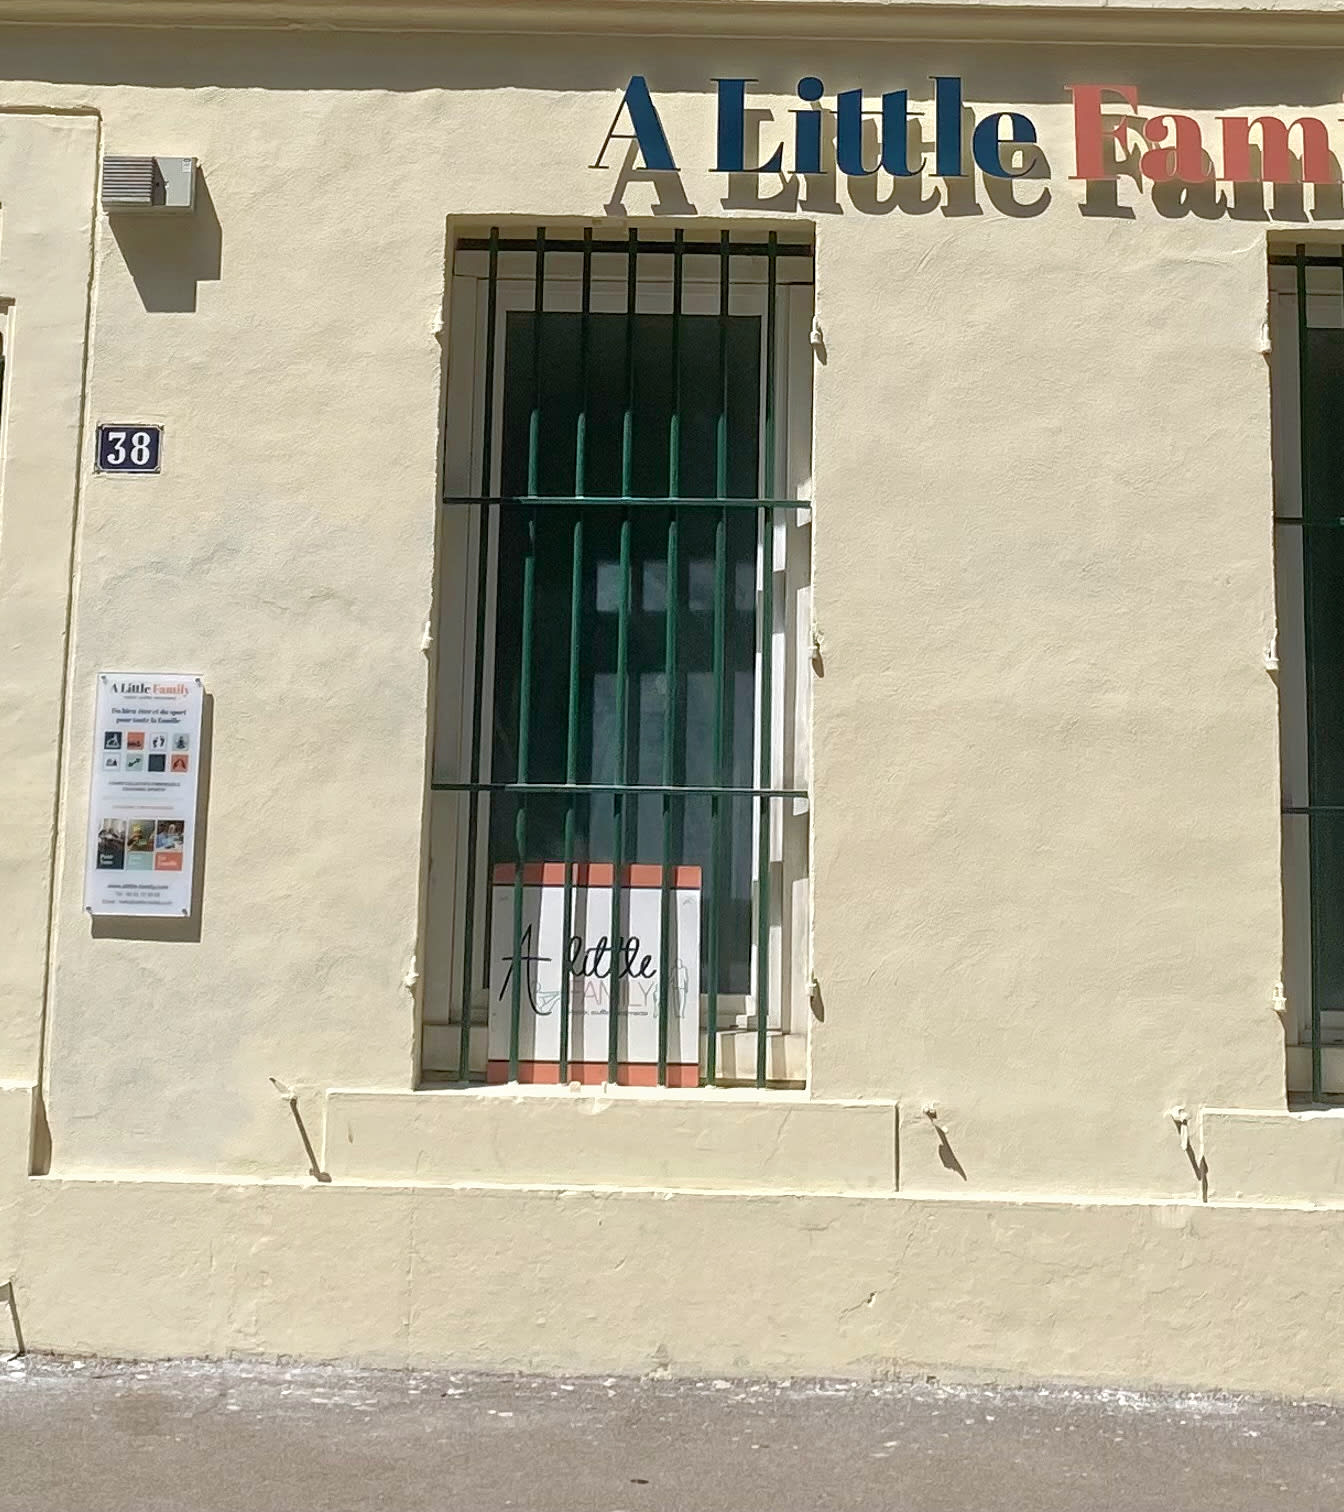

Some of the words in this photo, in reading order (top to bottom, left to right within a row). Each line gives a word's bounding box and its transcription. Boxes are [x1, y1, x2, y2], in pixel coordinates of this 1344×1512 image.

[587, 75, 681, 172] A
[708, 75, 1040, 178] Little
[107, 431, 151, 465] 38
[112, 683, 118, 694] A
[120, 682, 151, 694] Little
[153, 683, 189, 698] Family
[499, 924, 553, 1016] A
